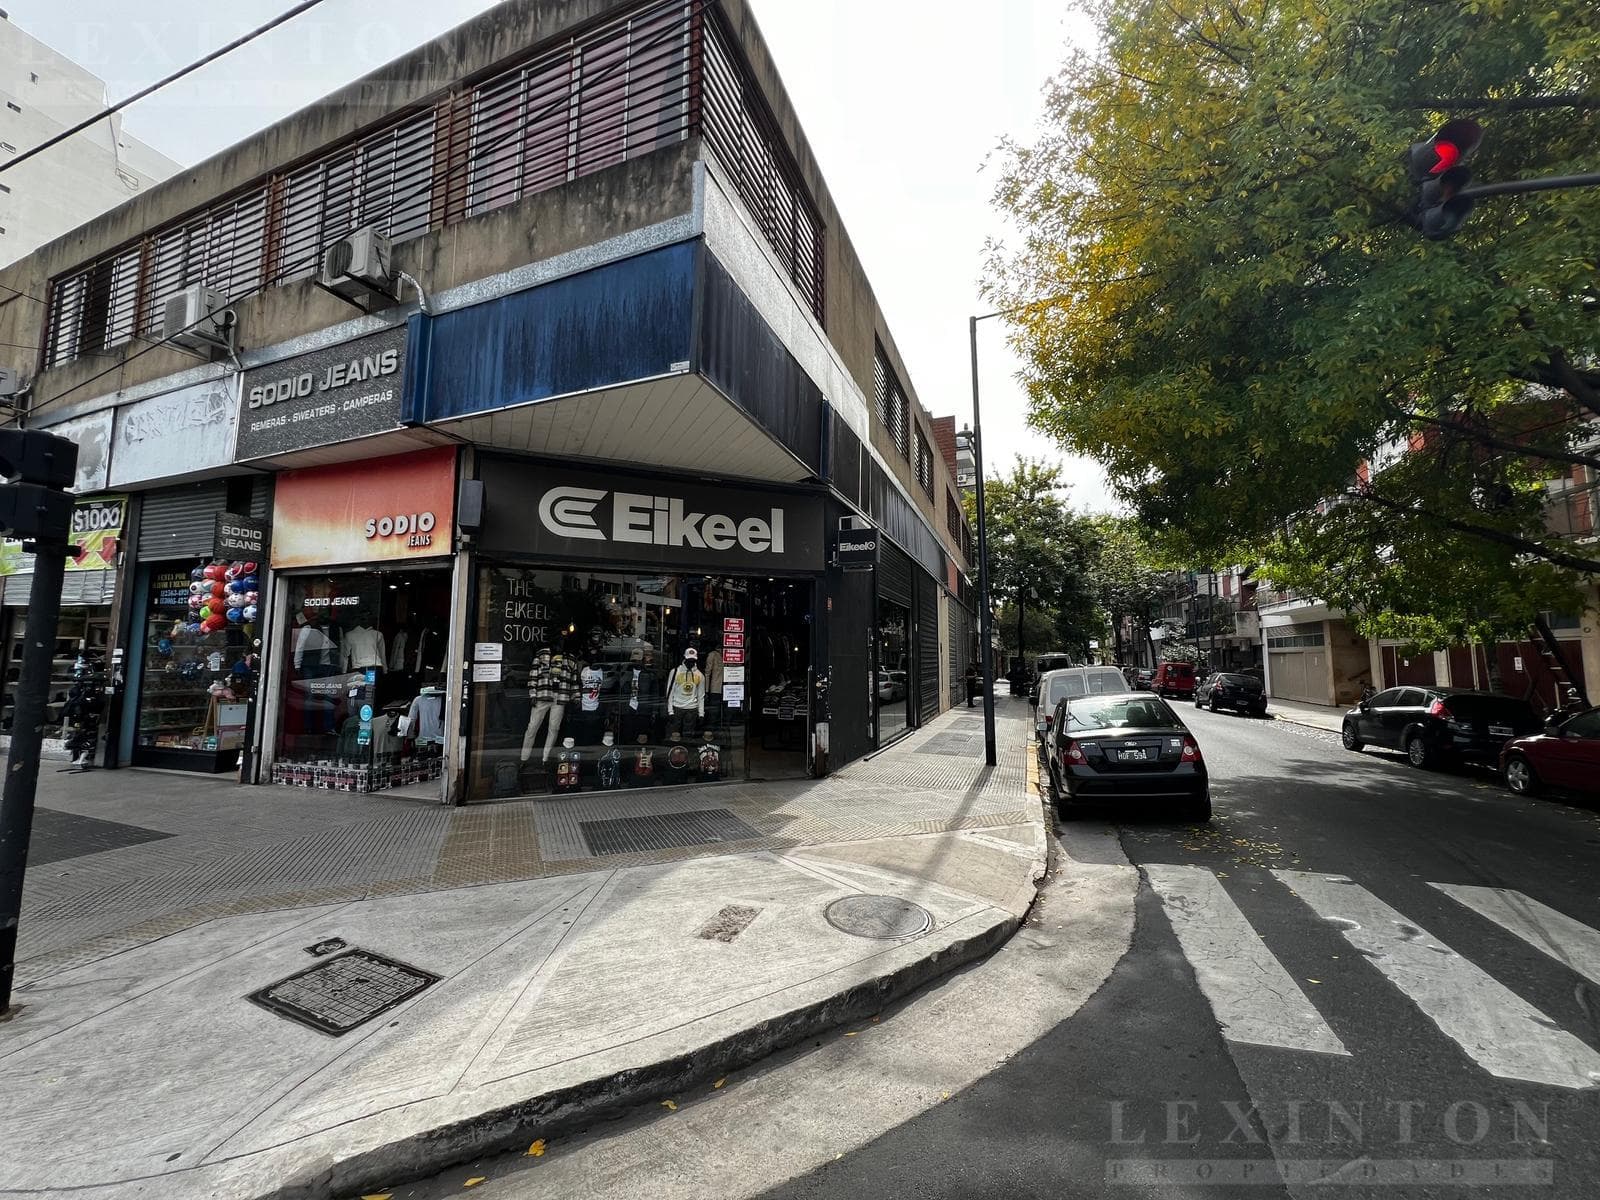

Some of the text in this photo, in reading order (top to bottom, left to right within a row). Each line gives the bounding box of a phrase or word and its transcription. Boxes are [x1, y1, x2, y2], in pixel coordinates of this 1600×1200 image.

[249, 349, 398, 409] SODIO JEANS
[250, 415, 287, 433] REMERAS
[292, 404, 336, 423] SWEATERS
[343, 389, 393, 412] CAMPERAS
[221, 525, 263, 540] SODIO
[365, 511, 436, 539] SODIO
[612, 491, 785, 554] Eikeel
[220, 538, 262, 552] JEANS
[407, 534, 432, 547] JEANS
[506, 577, 534, 598] THE
[304, 595, 360, 607] SODIO JEANS
[504, 600, 552, 621] EIKEEL
[503, 623, 550, 643] STORE
